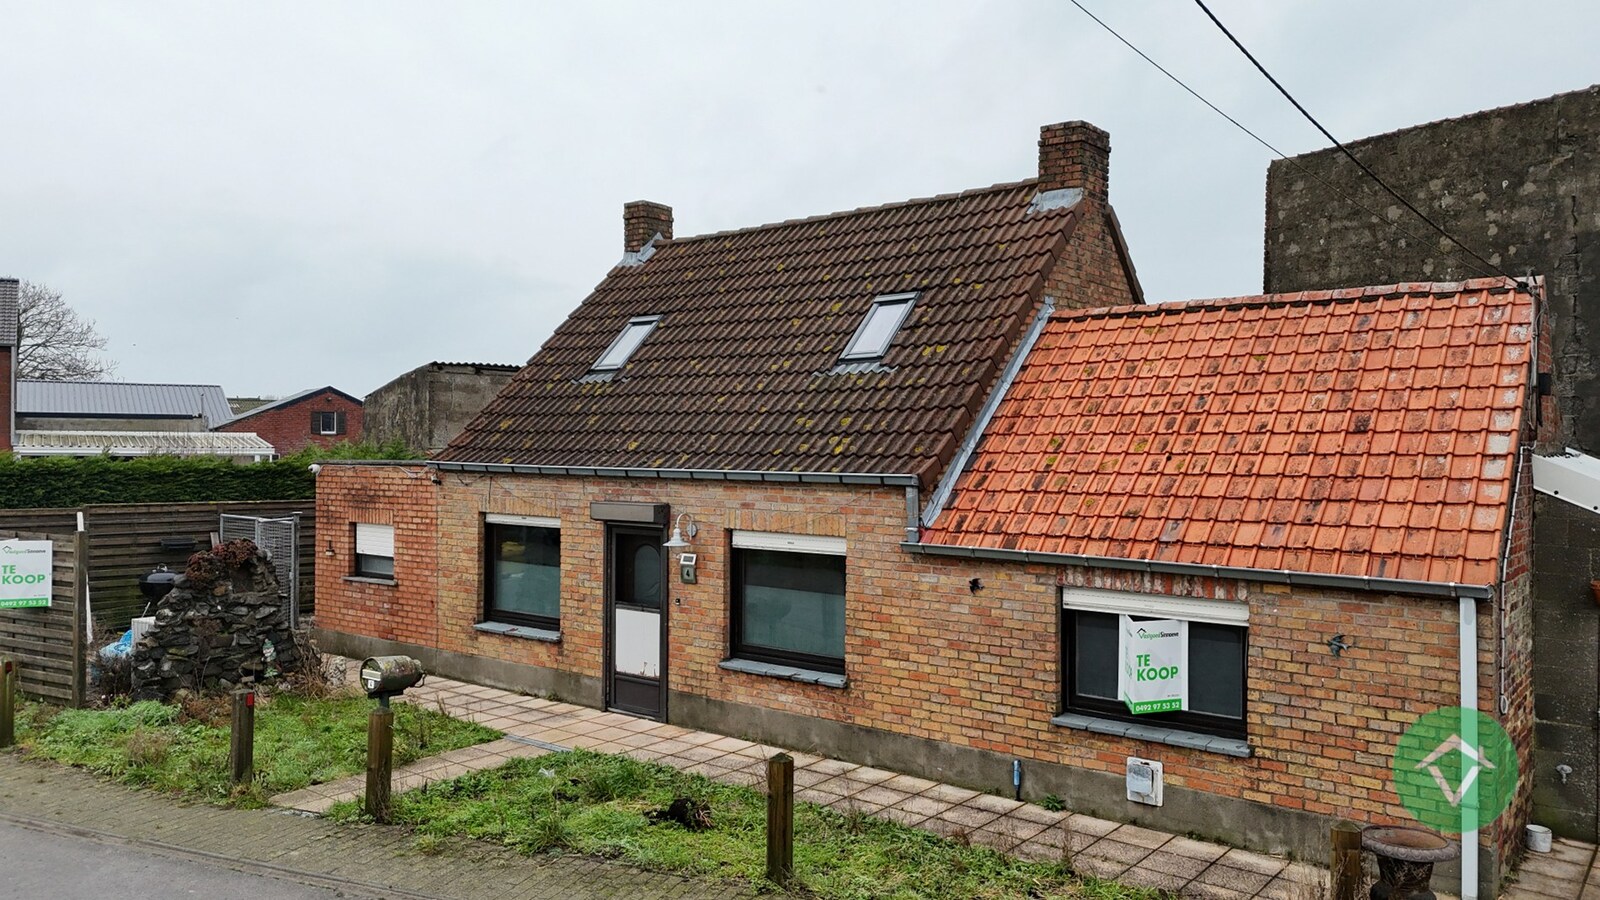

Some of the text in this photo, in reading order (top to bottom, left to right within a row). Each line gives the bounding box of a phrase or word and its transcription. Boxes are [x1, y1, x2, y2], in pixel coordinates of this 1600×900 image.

[2, 565, 16, 574] TE
[2, 575, 45, 584] KOOP
[1136, 654, 1150, 667] TE
[1137, 666, 1178, 681] KOOP
